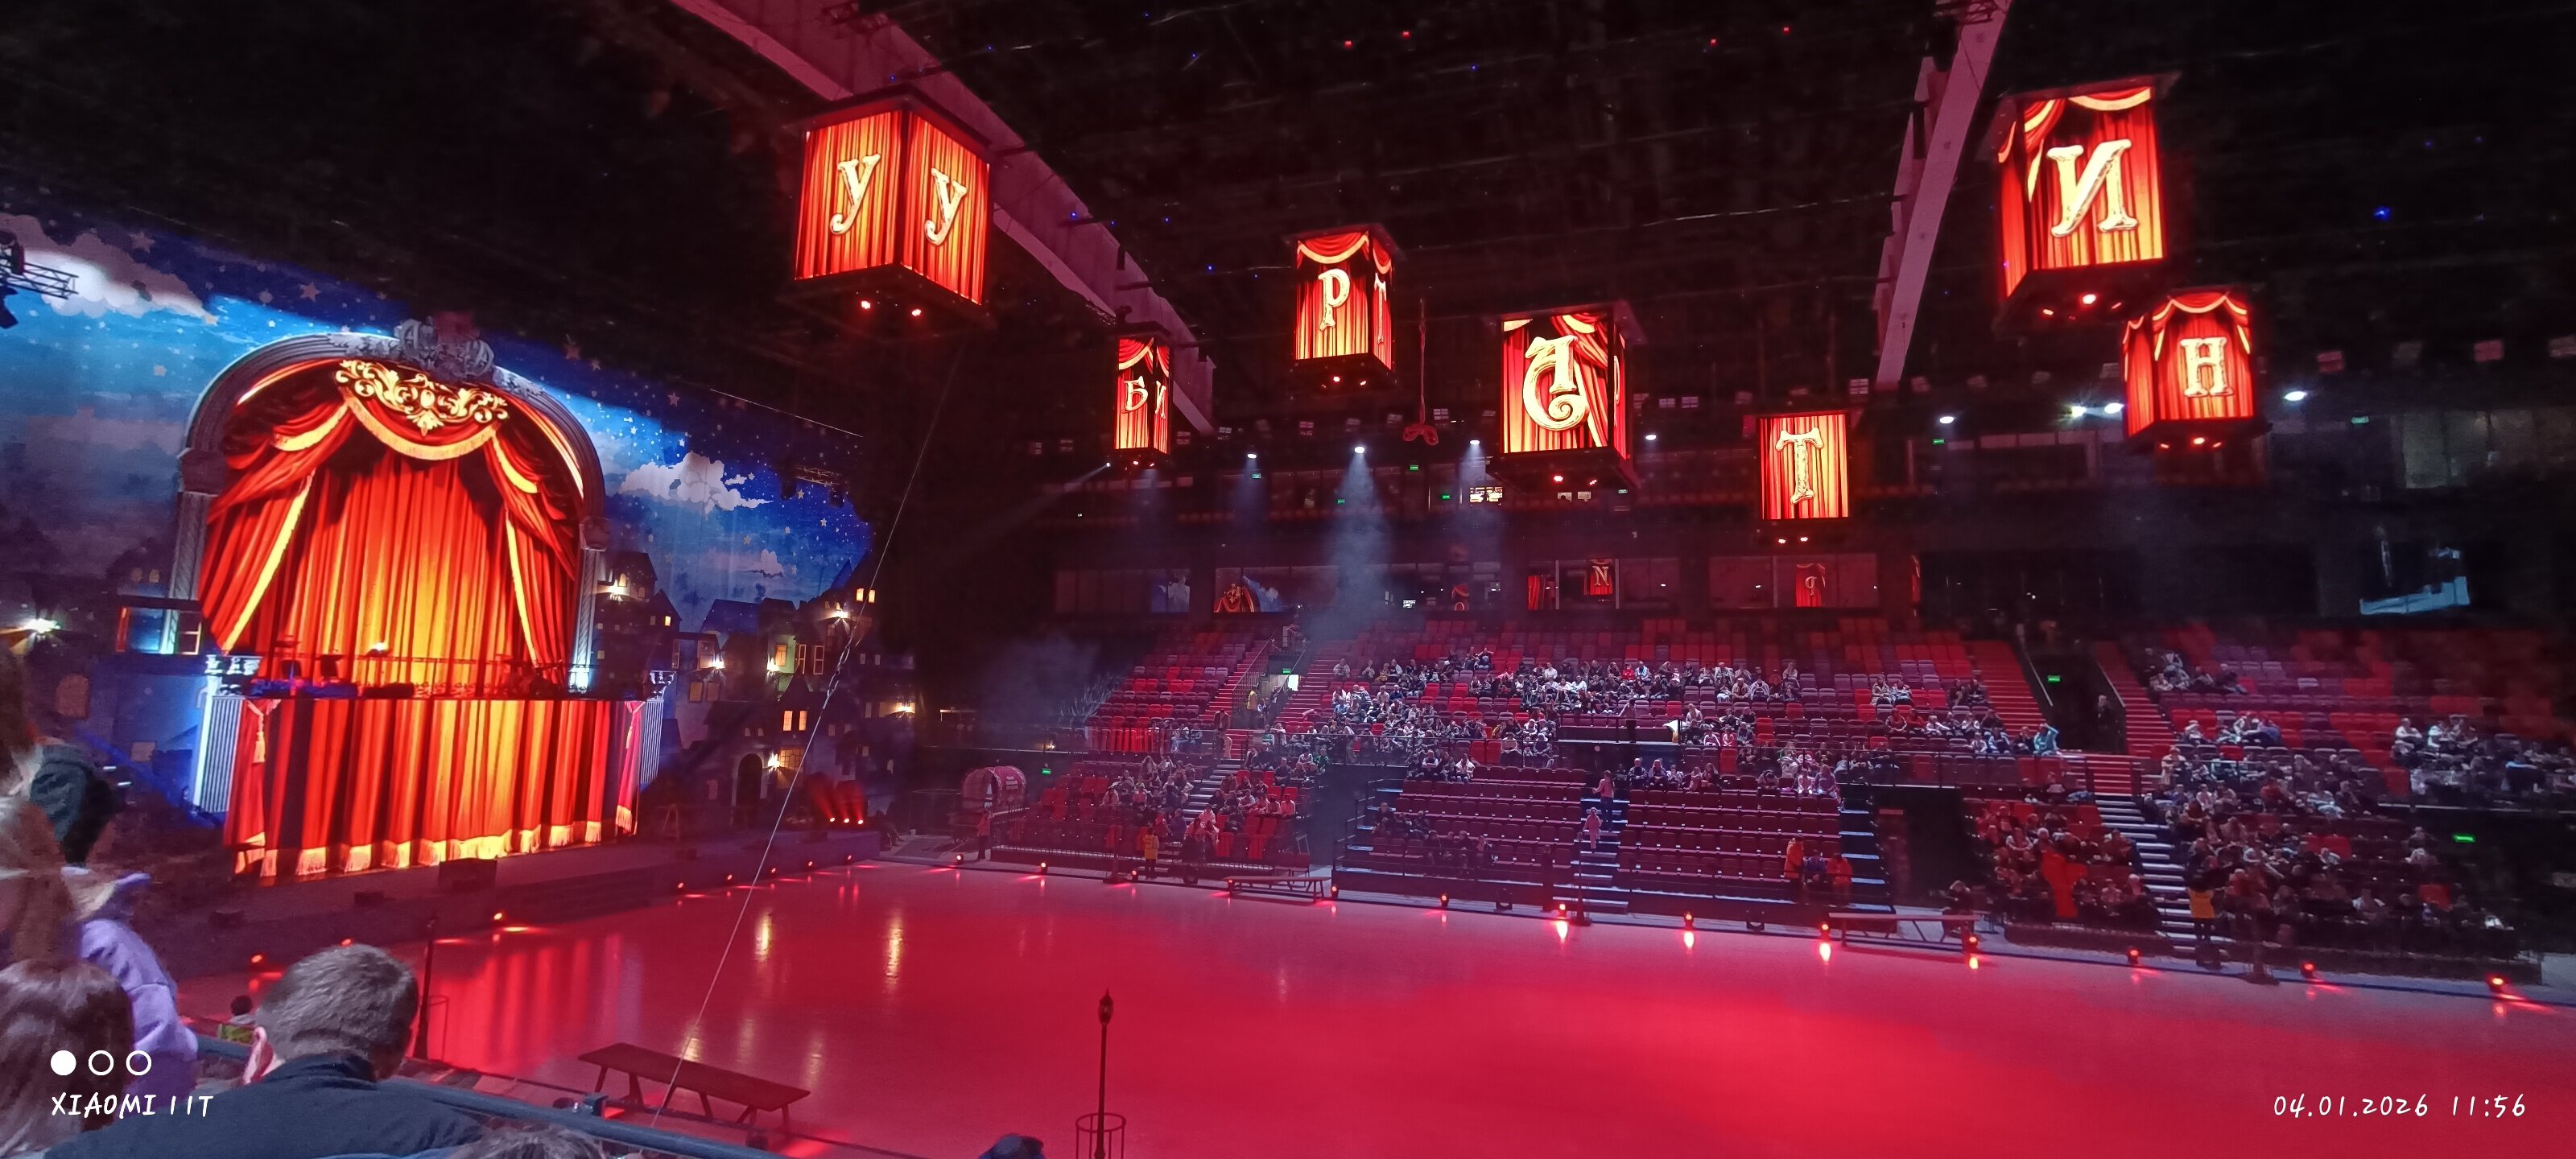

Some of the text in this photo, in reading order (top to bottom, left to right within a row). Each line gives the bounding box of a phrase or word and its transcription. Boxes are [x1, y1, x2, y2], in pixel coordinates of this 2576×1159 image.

[2046, 138, 2138, 237] И
[1318, 268, 1351, 332] Р
[1121, 375, 1149, 415] Б
[1523, 335, 1591, 431] А
[2180, 336, 2234, 397] Н
[1154, 380, 1167, 420] И
[1775, 427, 1824, 505] Т
